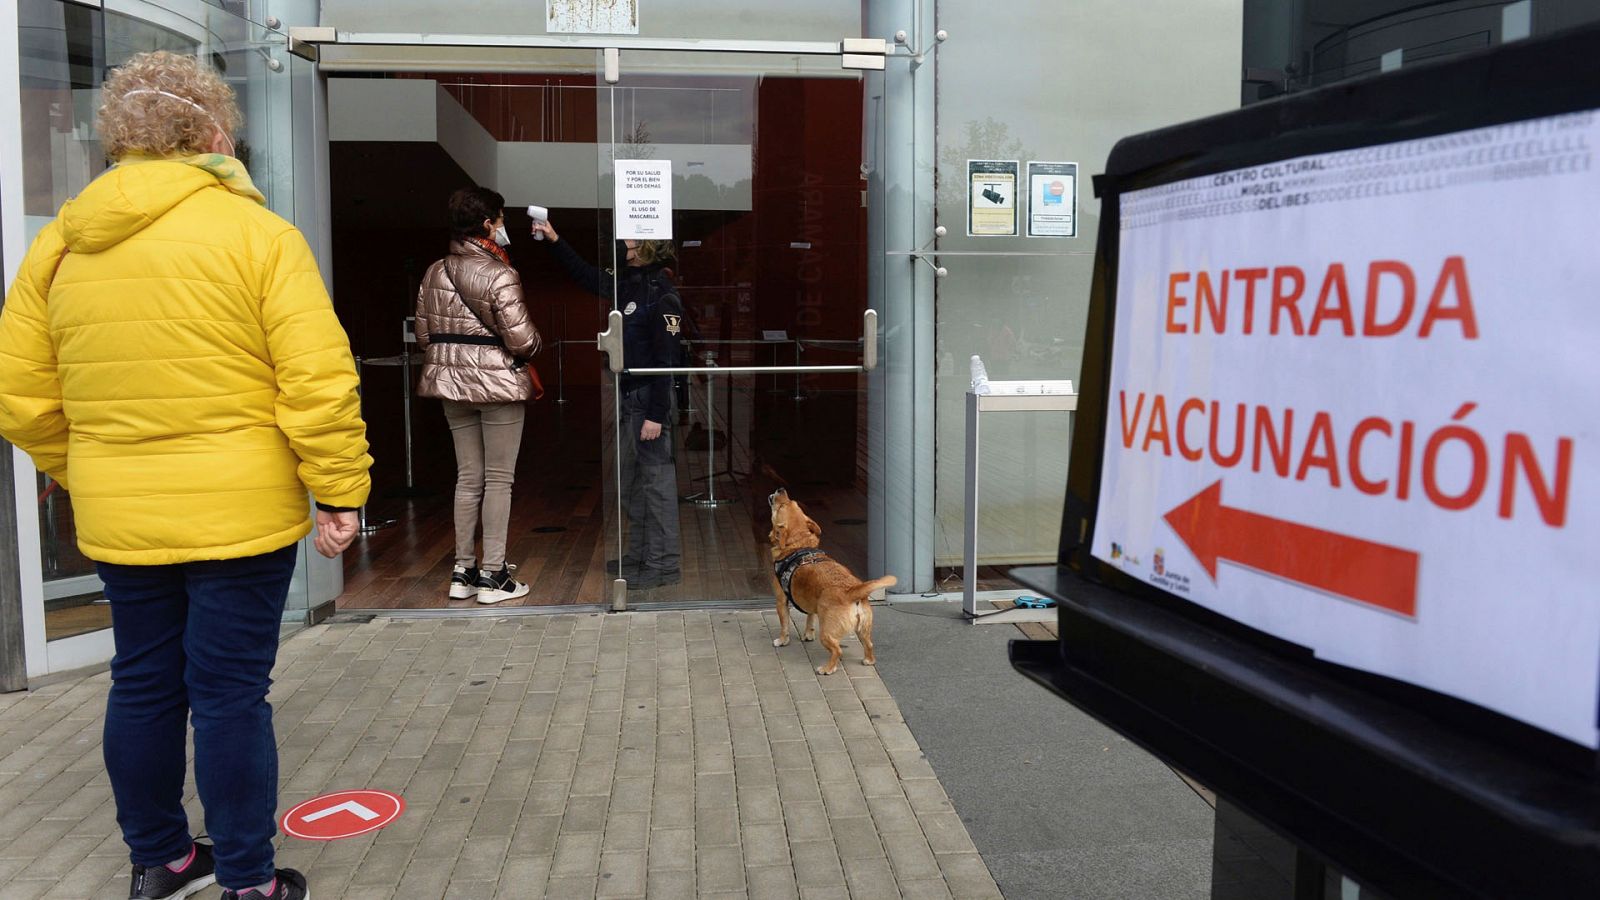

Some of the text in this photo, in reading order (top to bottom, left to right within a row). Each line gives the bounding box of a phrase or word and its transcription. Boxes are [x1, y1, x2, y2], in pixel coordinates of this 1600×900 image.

[1213, 159, 1326, 187] CENTRO CULTURAL
[1241, 180, 1283, 197] MIGUEL
[1259, 192, 1311, 211] DELIBES
[1166, 256, 1479, 339] ENTRADA
[1119, 390, 1574, 528] VACUNACIÓN
